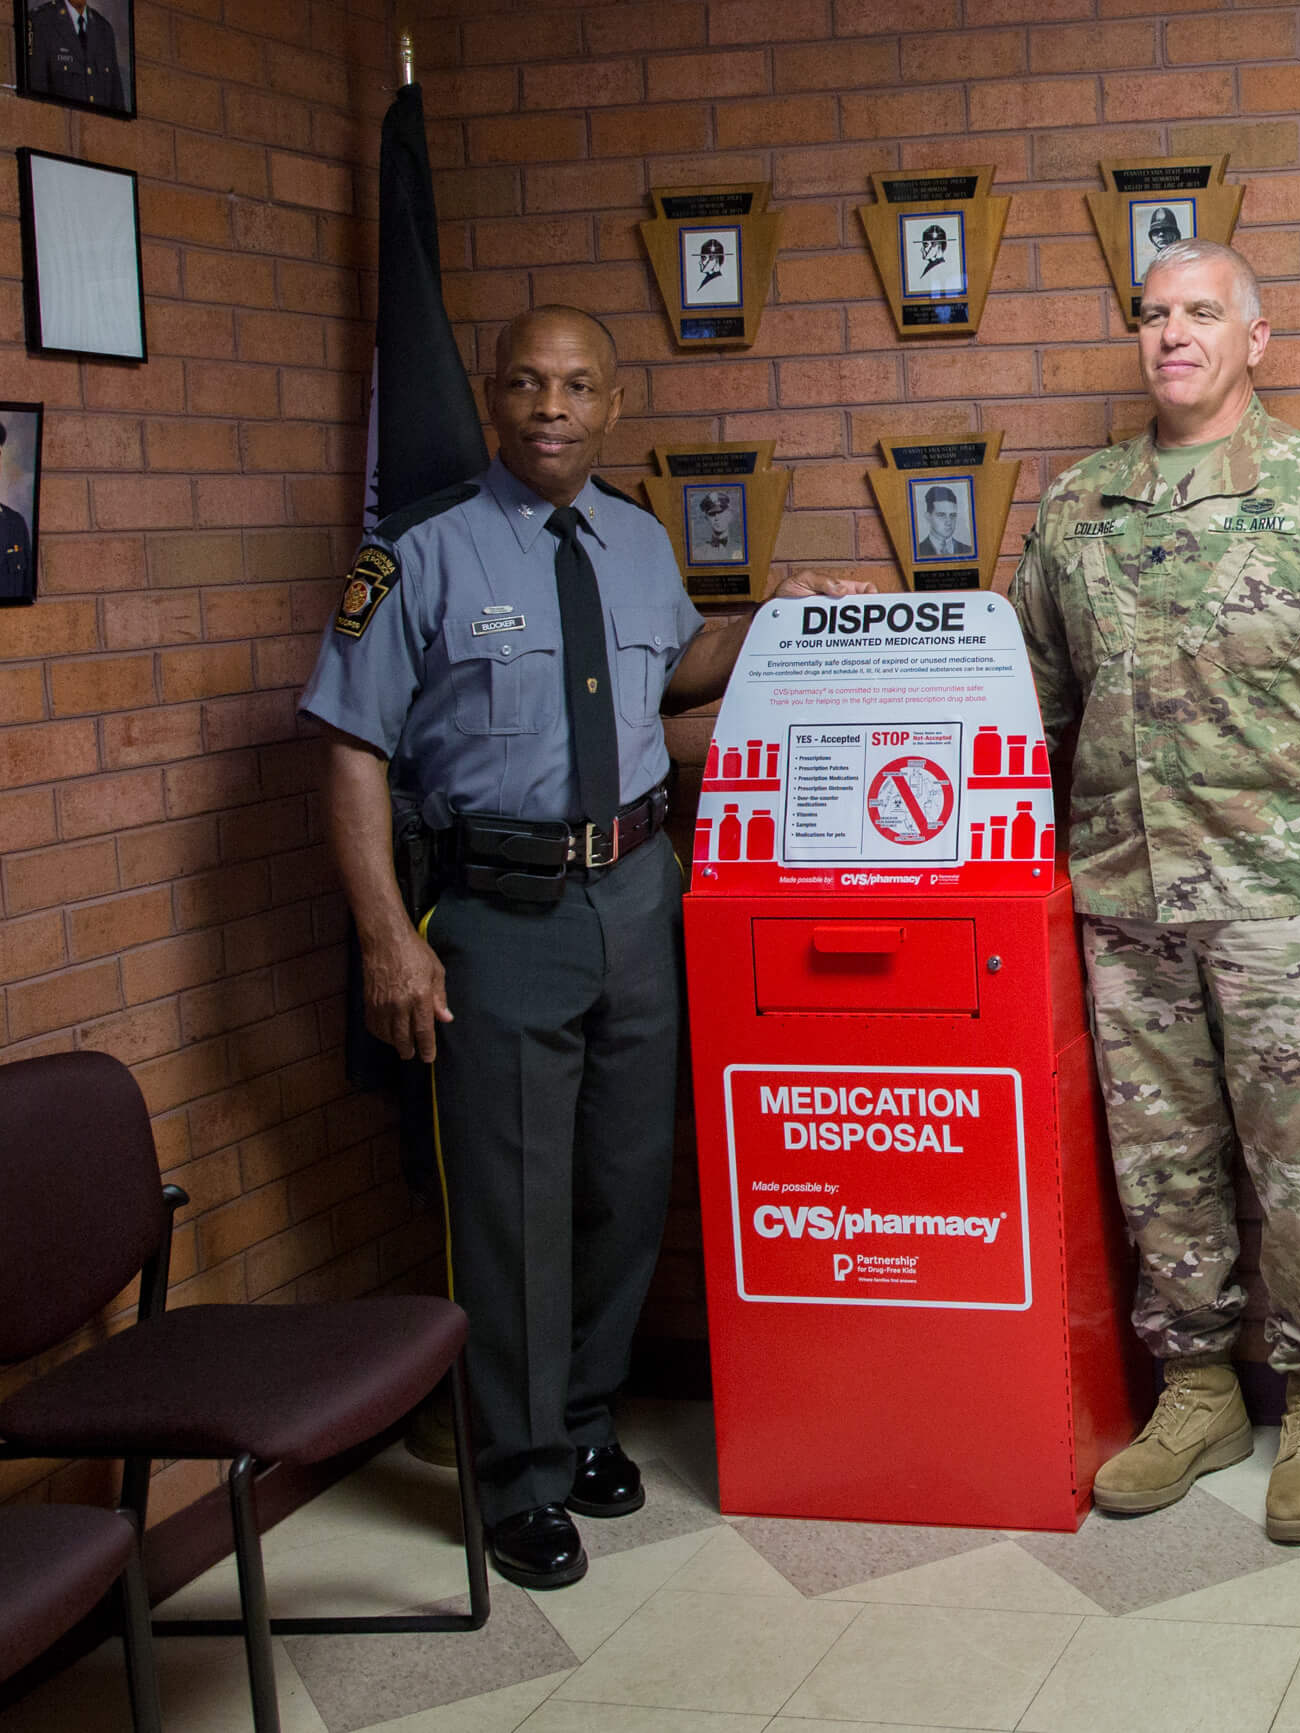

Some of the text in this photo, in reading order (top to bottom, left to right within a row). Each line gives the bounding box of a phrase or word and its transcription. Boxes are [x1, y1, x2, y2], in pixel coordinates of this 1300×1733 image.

[1074, 520, 1115, 536] COLLAGE
[1223, 517, 1287, 531] U.S. ARMY
[481, 619, 516, 631] BLOCKER
[802, 602, 966, 634] DISPOSE
[779, 635, 987, 649] OF YOUR UNWANTED MEDICATIONS HERE
[767, 660, 822, 668] Environmentally
[841, 658, 871, 667] disposal
[882, 657, 908, 666] expired
[804, 669, 820, 677] drugs
[882, 686, 906, 694] making
[816, 698, 840, 706] helping
[879, 696, 904, 704] against
[905, 696, 946, 704] prescription
[947, 695, 963, 703] drug
[796, 735, 812, 744] YES
[821, 734, 860, 744] Accepted
[872, 731, 910, 746] STOP
[797, 876, 823, 884] possible
[760, 1086, 980, 1117] MEDICATION
[783, 1122, 964, 1153] DISPOSAL
[752, 1181, 839, 1195] Made possible by:
